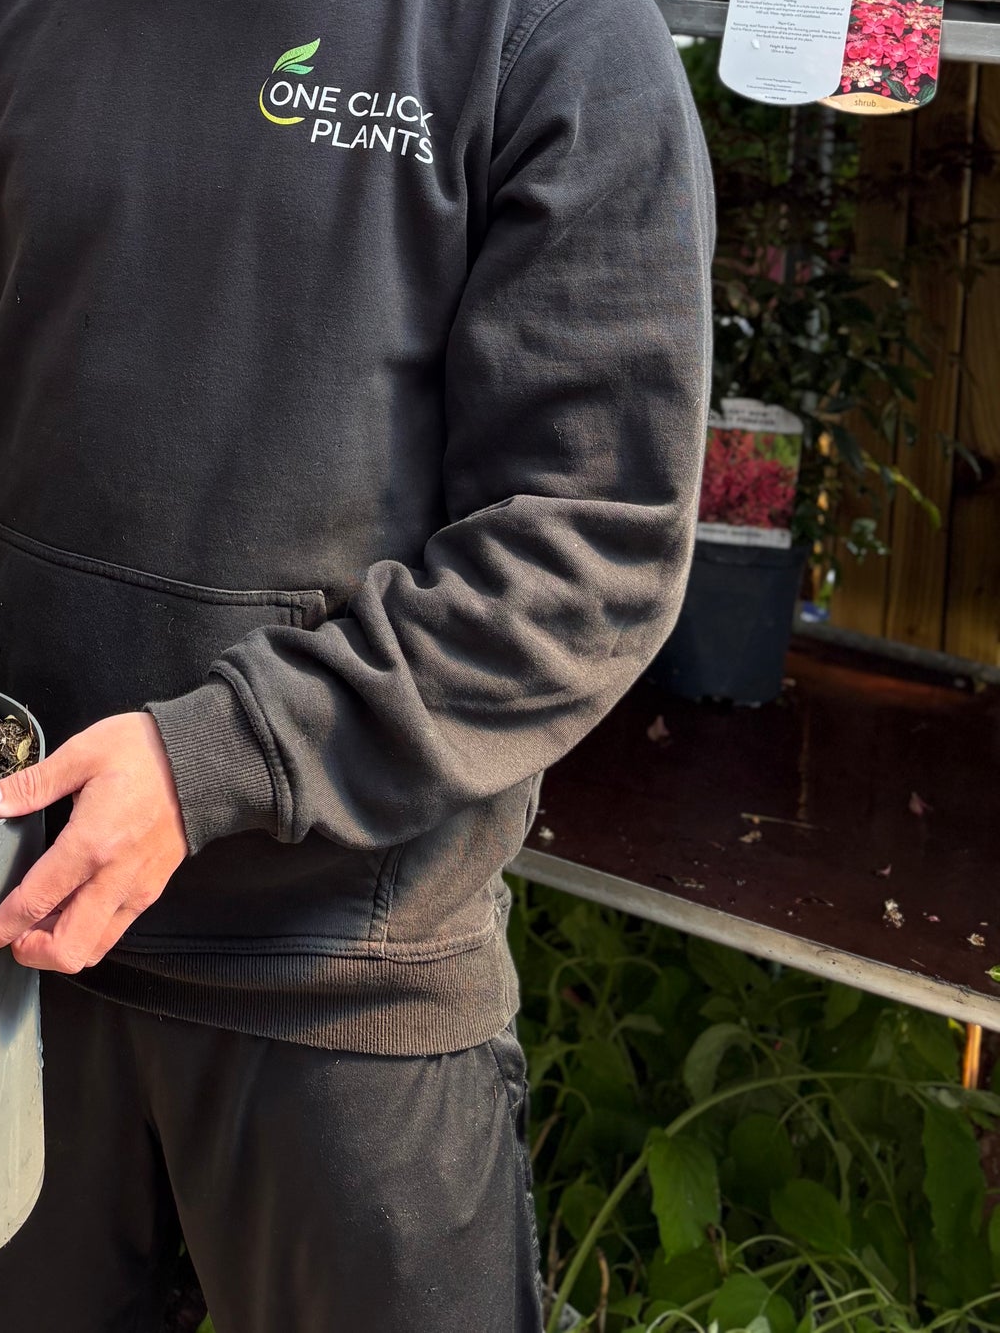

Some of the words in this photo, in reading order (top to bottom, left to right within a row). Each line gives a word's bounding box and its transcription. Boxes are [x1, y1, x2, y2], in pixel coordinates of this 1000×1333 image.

[269, 80, 341, 113] ONE
[348, 91, 434, 136] CLICK
[854, 99, 877, 107] shrub
[310, 118, 434, 164] PLANTS
